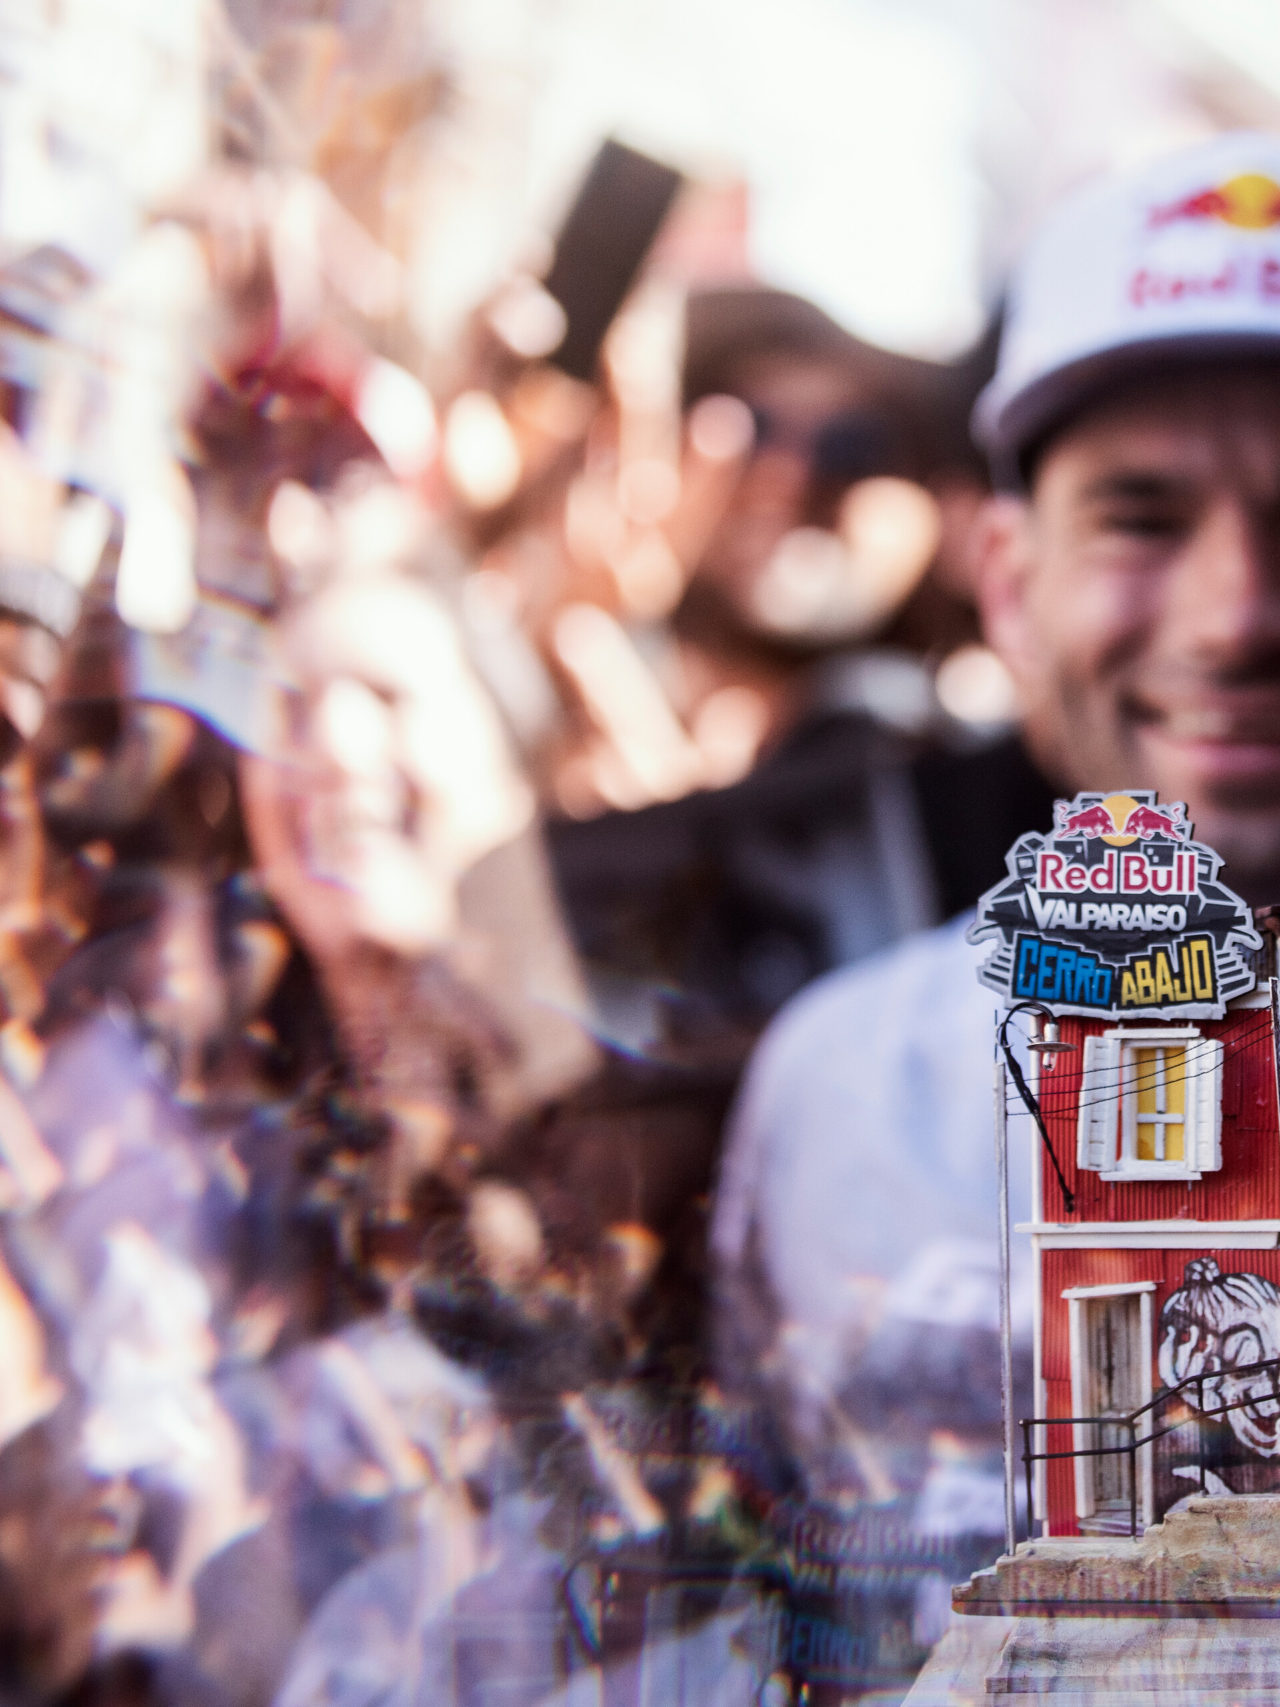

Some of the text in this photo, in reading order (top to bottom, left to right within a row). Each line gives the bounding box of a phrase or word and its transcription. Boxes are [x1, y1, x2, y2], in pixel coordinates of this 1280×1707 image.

[1128, 254, 1240, 309] Red
[1039, 852, 1197, 893] Red Bull
[1024, 883, 1188, 931] VALPARAISO
[1015, 939, 1213, 1006] CERRO ABAJO
